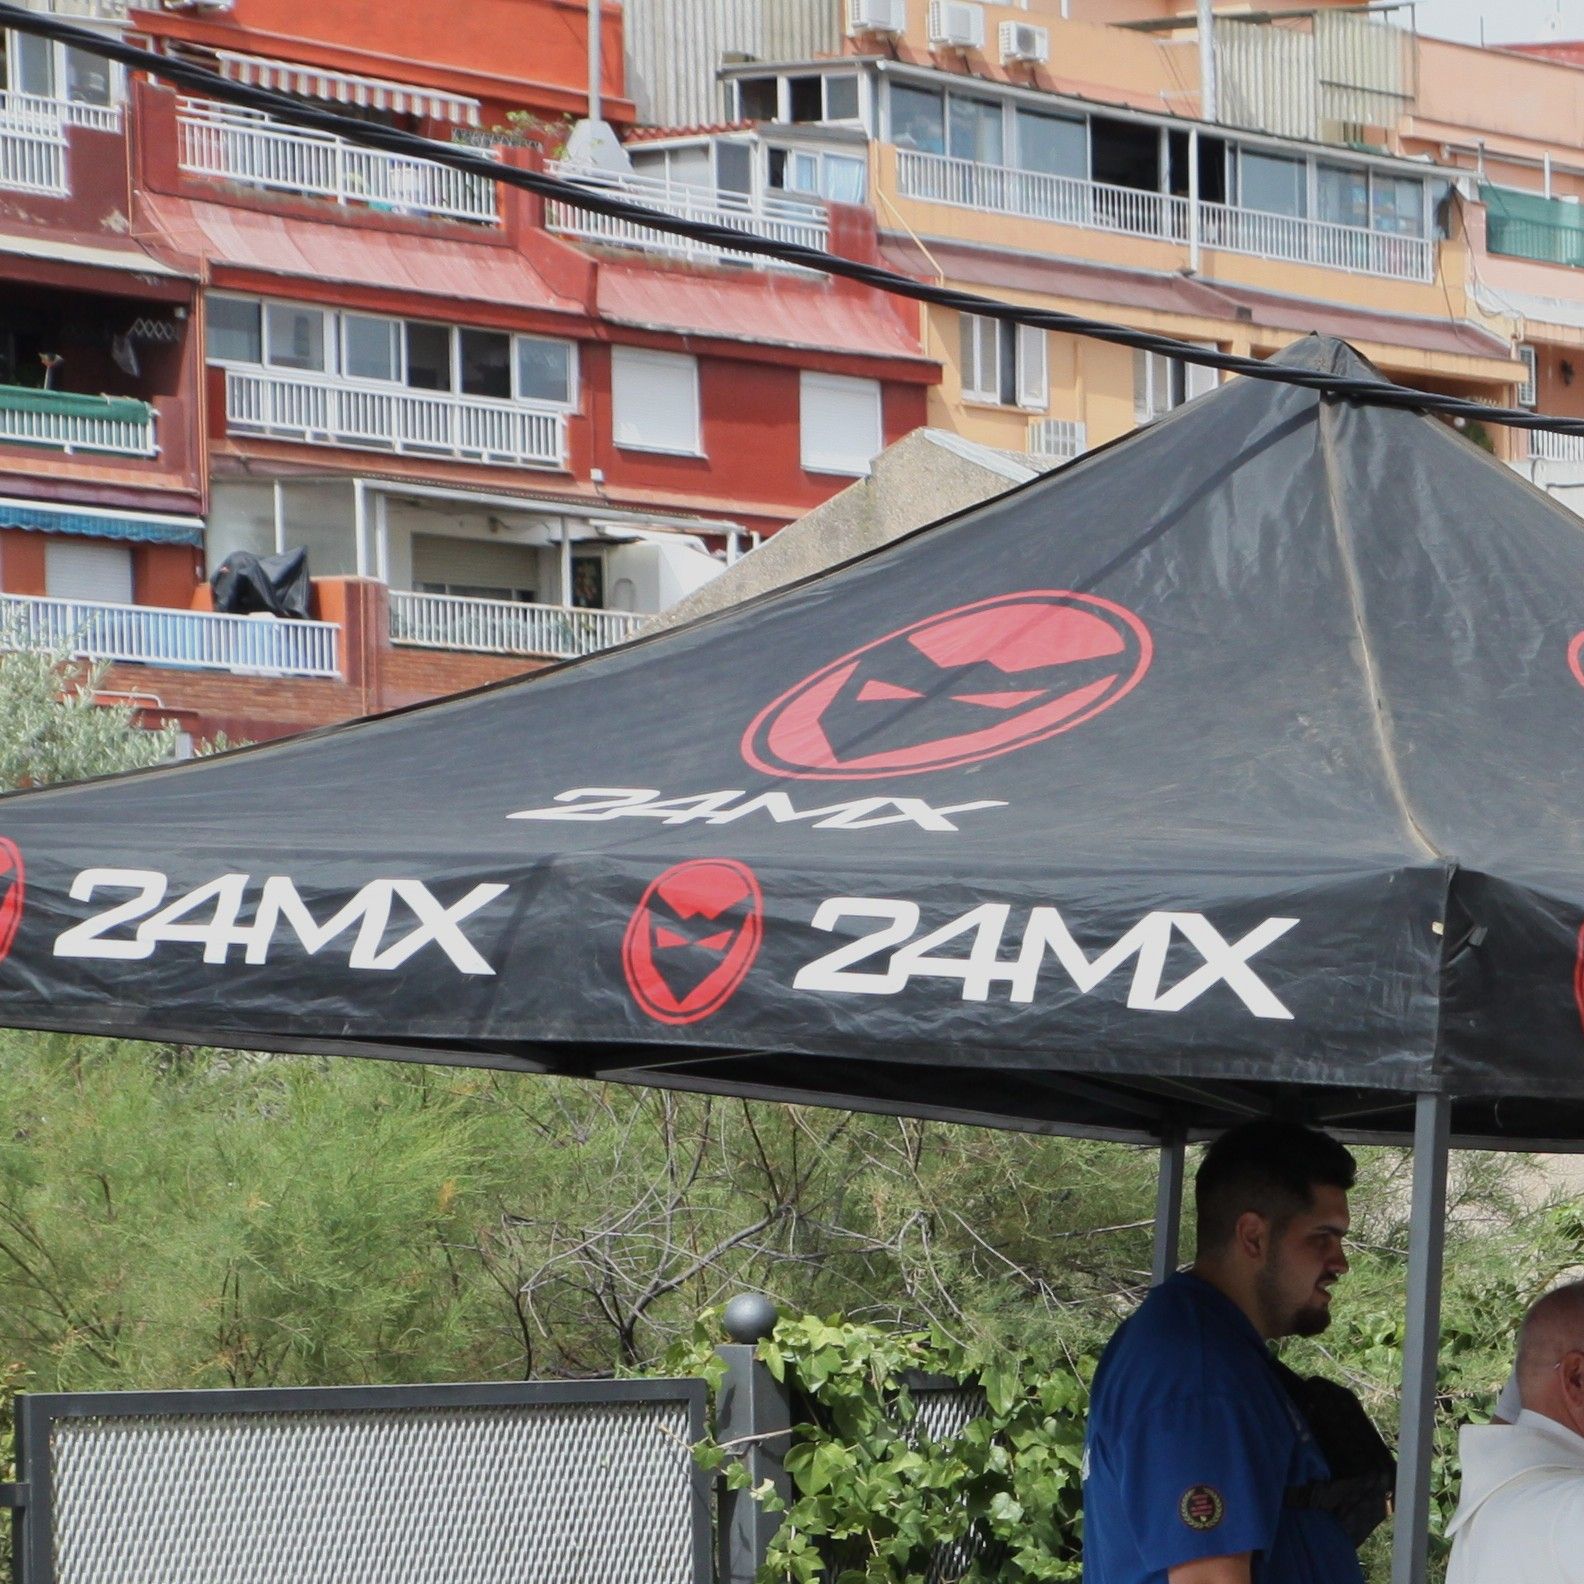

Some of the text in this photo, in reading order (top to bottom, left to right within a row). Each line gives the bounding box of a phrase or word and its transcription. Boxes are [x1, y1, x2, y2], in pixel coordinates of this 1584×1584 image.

[506, 787, 1009, 831] 24MX
[53, 867, 509, 975] 24MX
[792, 896, 1301, 1021] 24MX
